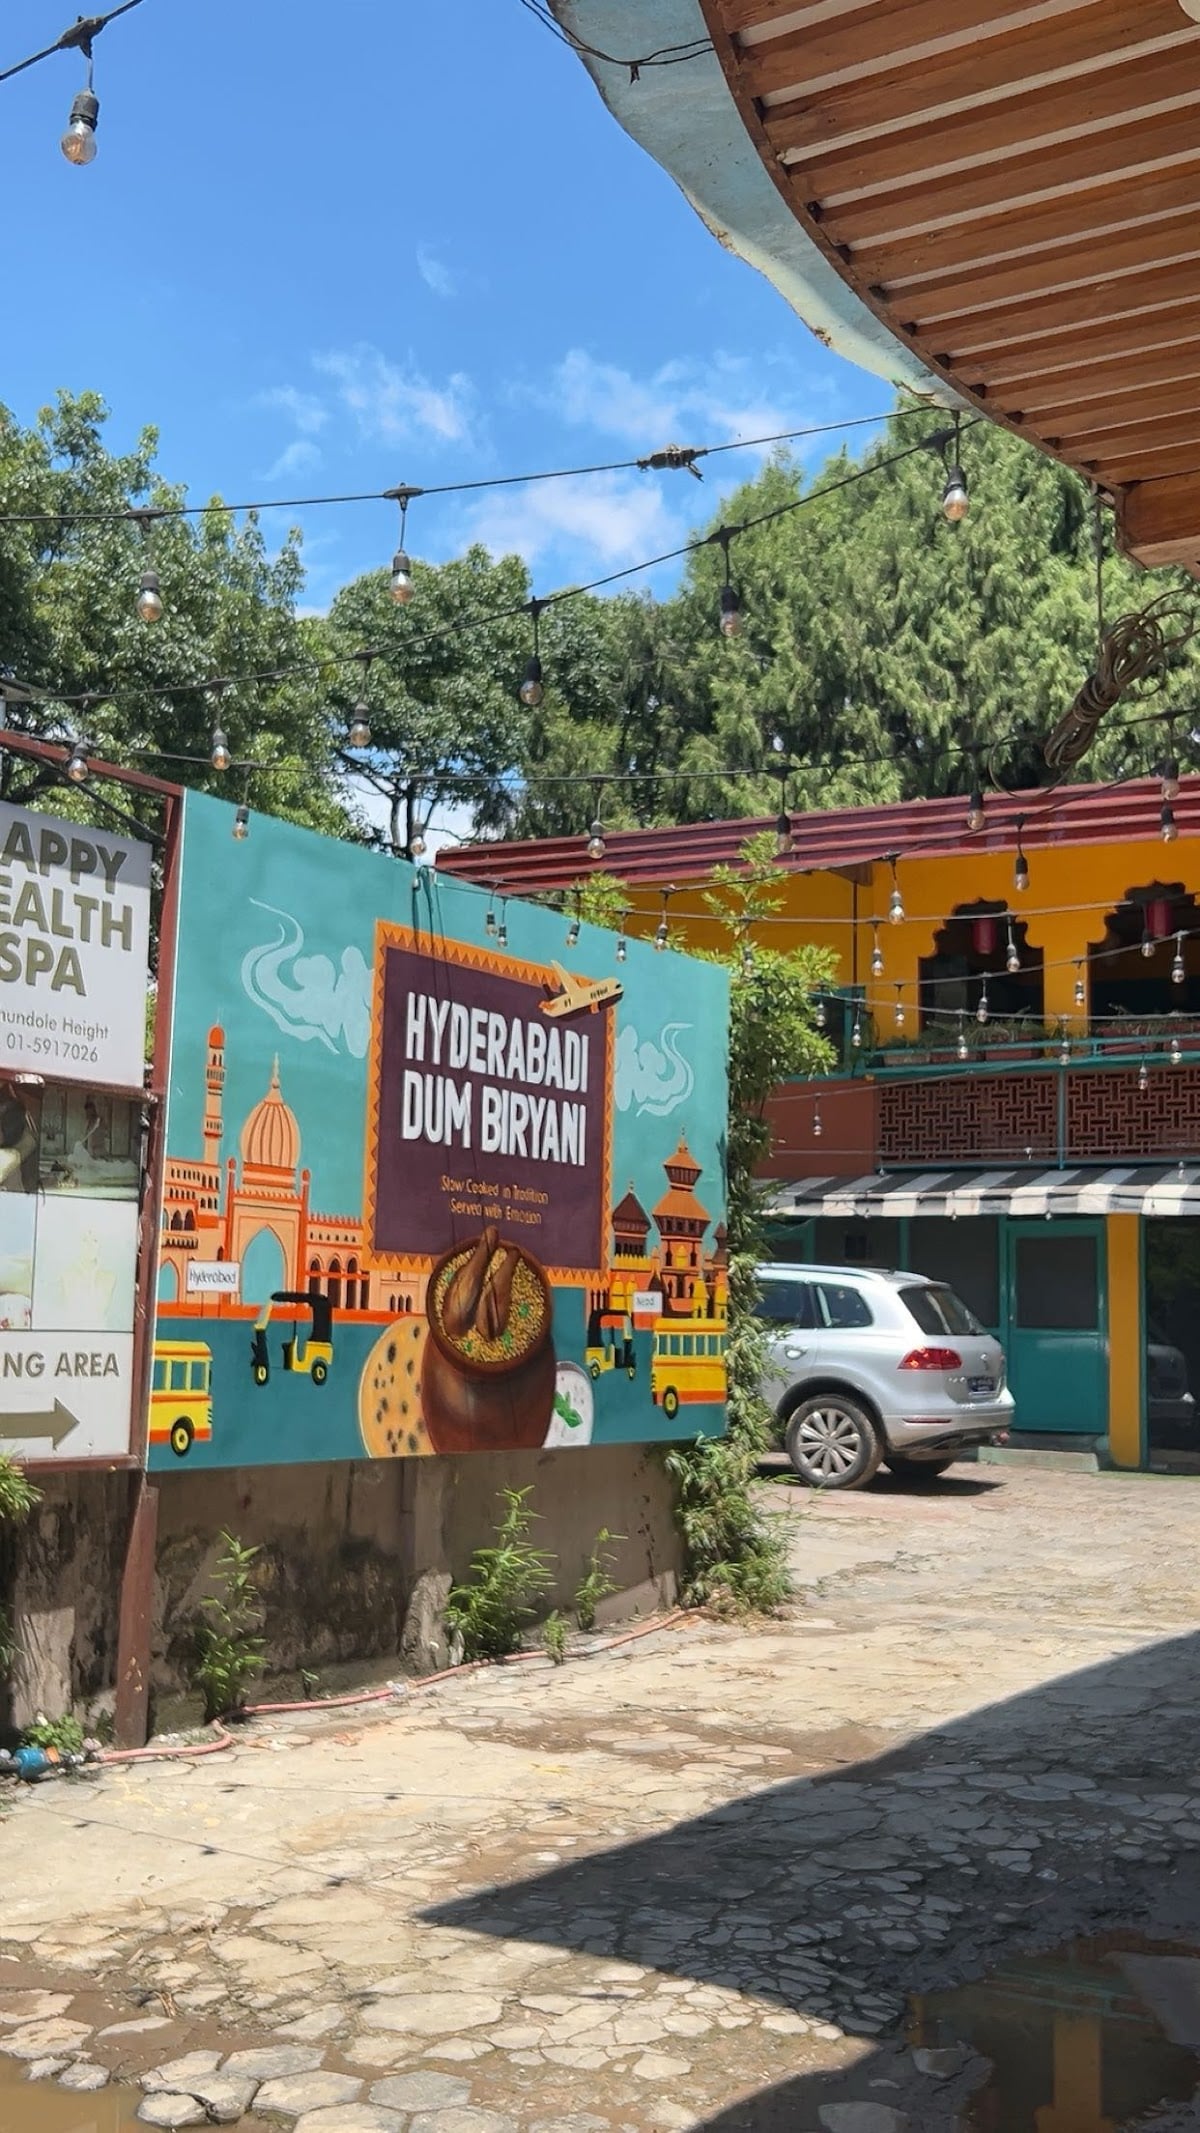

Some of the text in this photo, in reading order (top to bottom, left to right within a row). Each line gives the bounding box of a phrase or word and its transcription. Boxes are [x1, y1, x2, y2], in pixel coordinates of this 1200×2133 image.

[0, 931, 87, 997] SPA
[62, 1016, 109, 1041] Height
[405, 991, 589, 1093] HYDERABADI
[6, 1032, 98, 1063] 01-5917026
[402, 1069, 587, 1166] DUM BIRYANI
[441, 1175, 464, 1192] Slow
[450, 1198, 482, 1216] Served
[189, 1269, 236, 1286] Hyderabad
[3, 1351, 120, 1378] NG AREA
